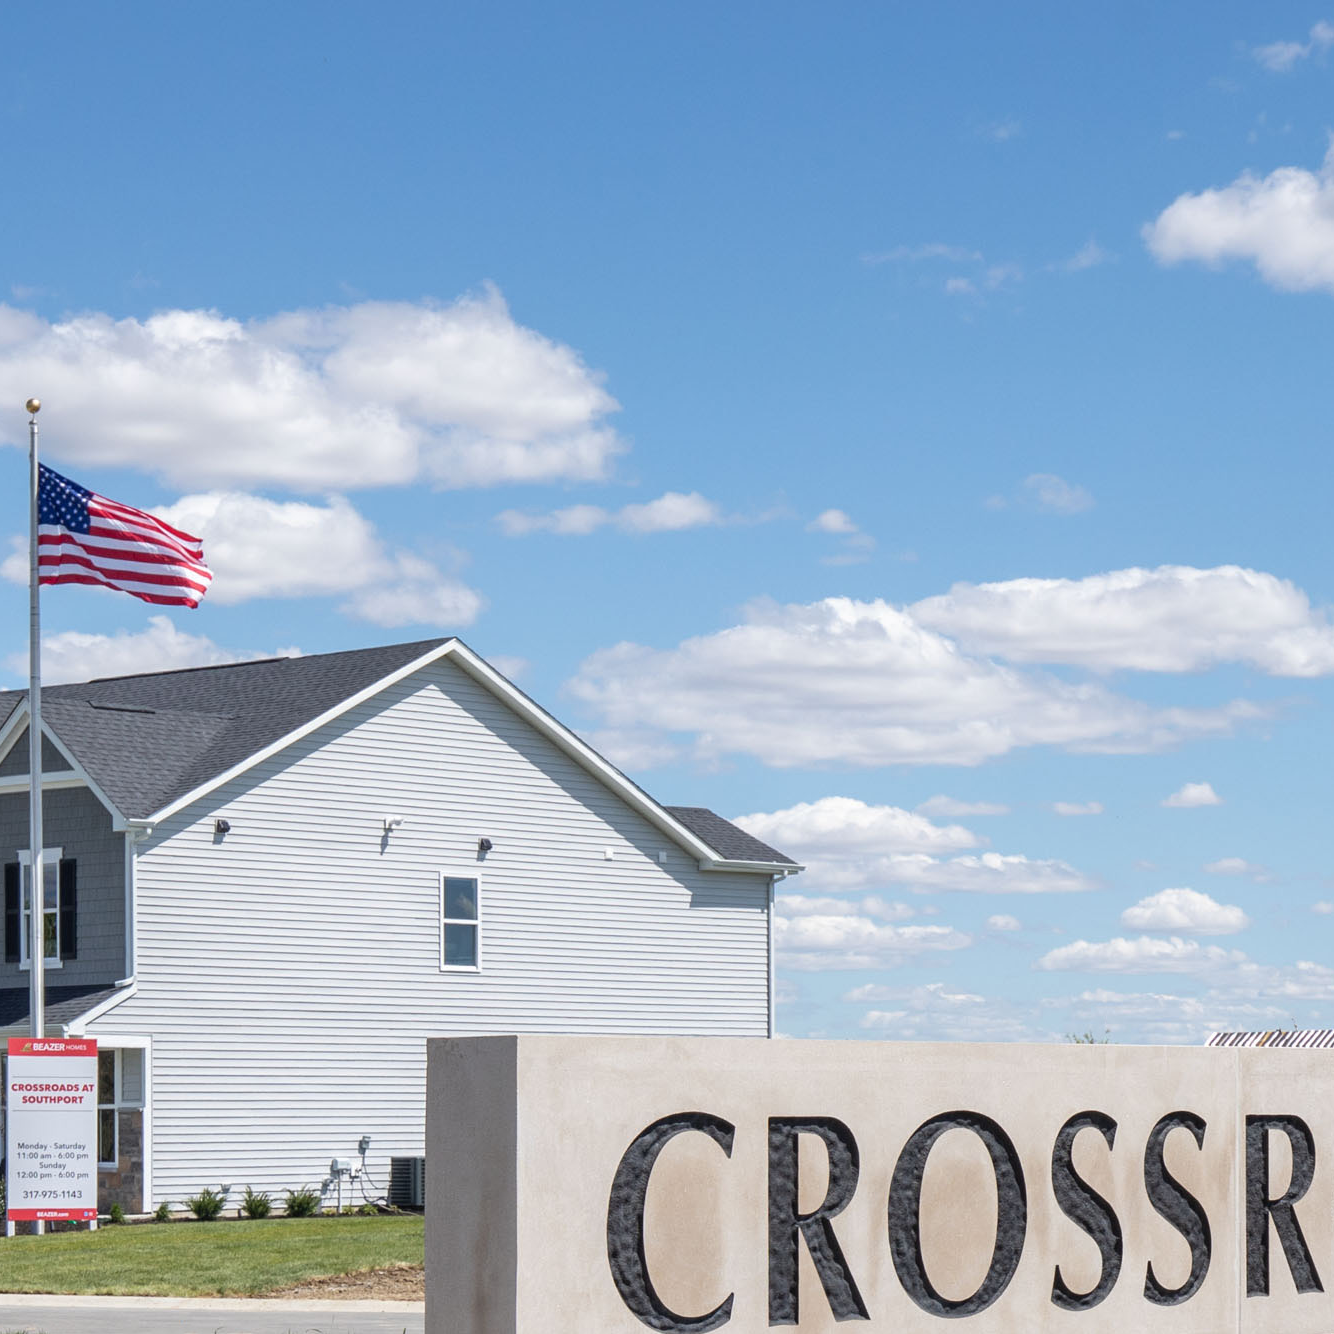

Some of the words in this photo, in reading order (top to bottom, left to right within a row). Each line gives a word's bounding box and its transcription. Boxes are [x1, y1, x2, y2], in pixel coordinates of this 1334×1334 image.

[33, 1043, 65, 1051] BEAZER
[11, 1083, 80, 1092] CROSSROADS
[81, 1084, 95, 1092] AT
[22, 1095, 84, 1104] SOUTHPORT
[17, 1142, 48, 1151] Monday
[53, 1142, 86, 1151] Saturday
[39, 1161, 66, 1170] Sunday
[22, 1190, 83, 1199] 317-975-1143
